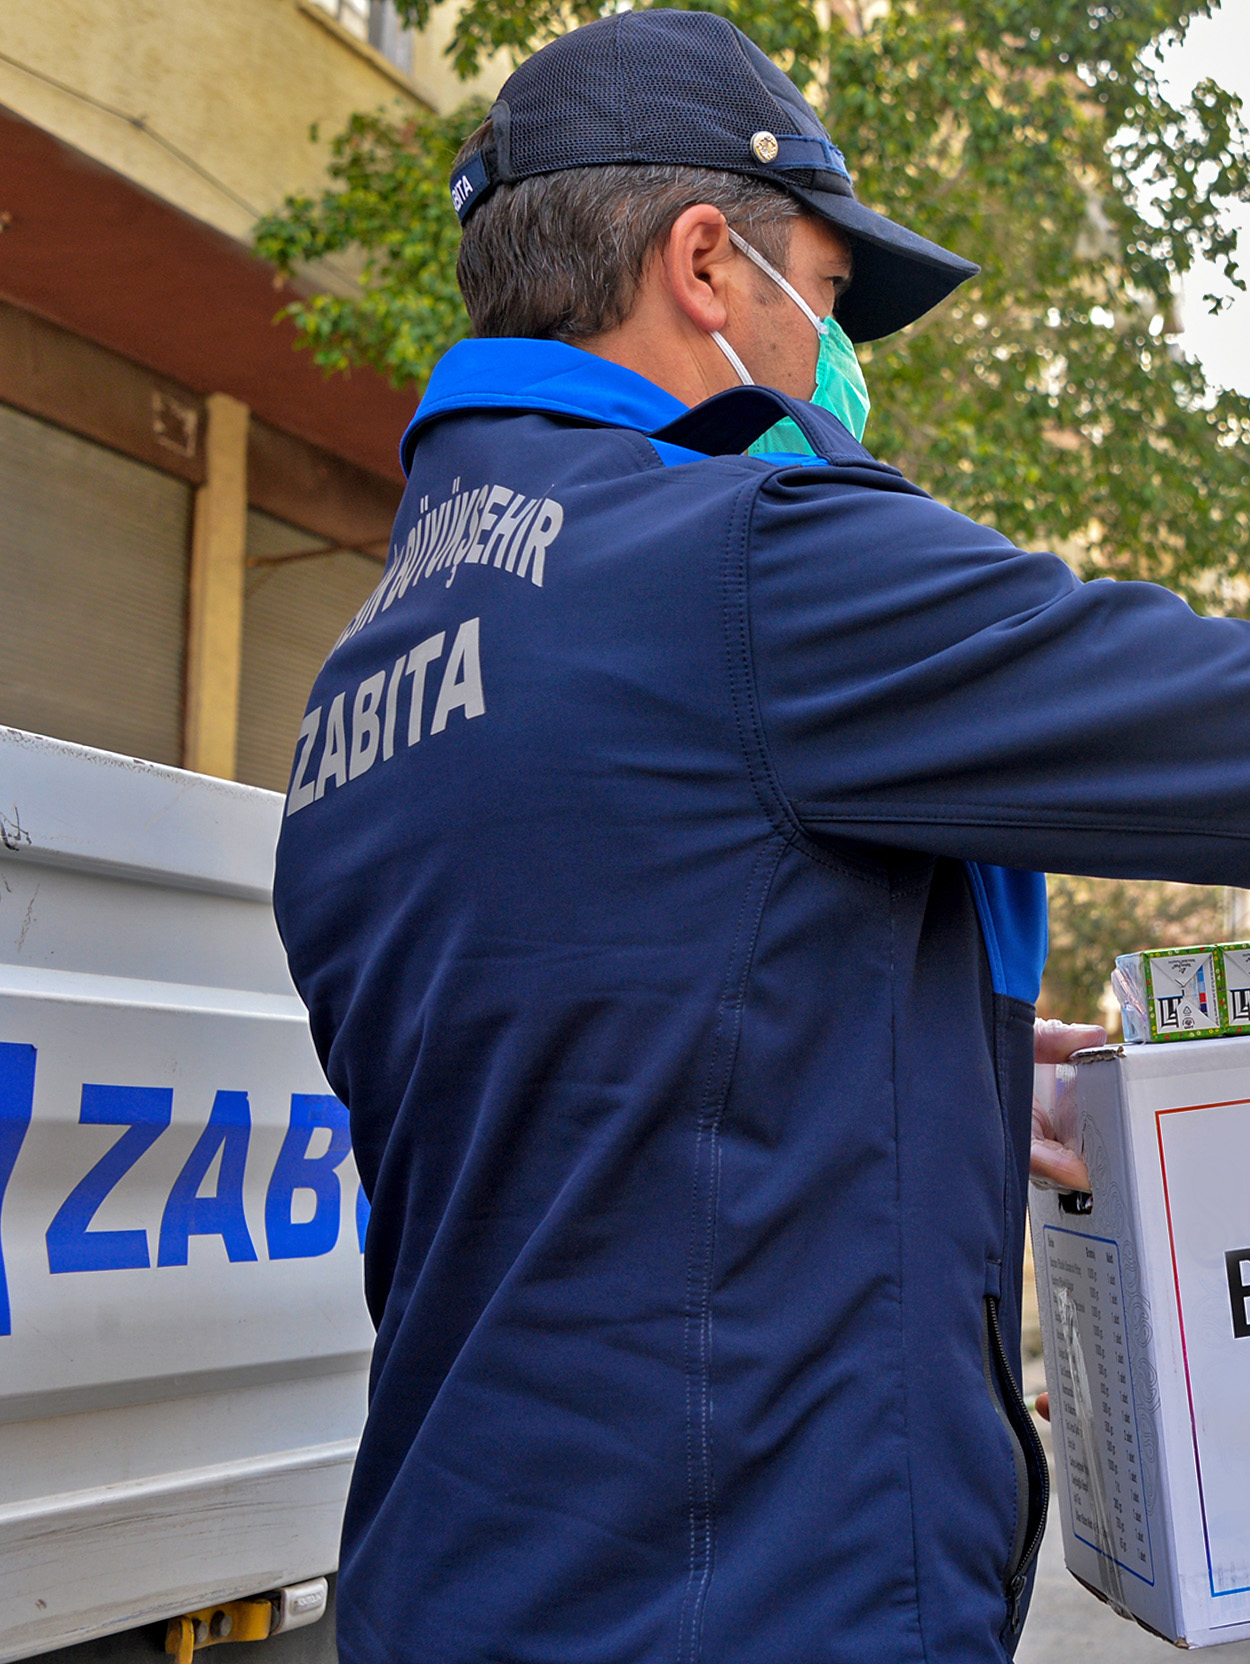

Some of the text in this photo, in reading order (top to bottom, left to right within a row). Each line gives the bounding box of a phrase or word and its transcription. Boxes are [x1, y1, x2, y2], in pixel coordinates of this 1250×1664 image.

[451, 175, 474, 213] BITA
[286, 616, 486, 818] ZABITA
[45, 1082, 373, 1275] ZAB
